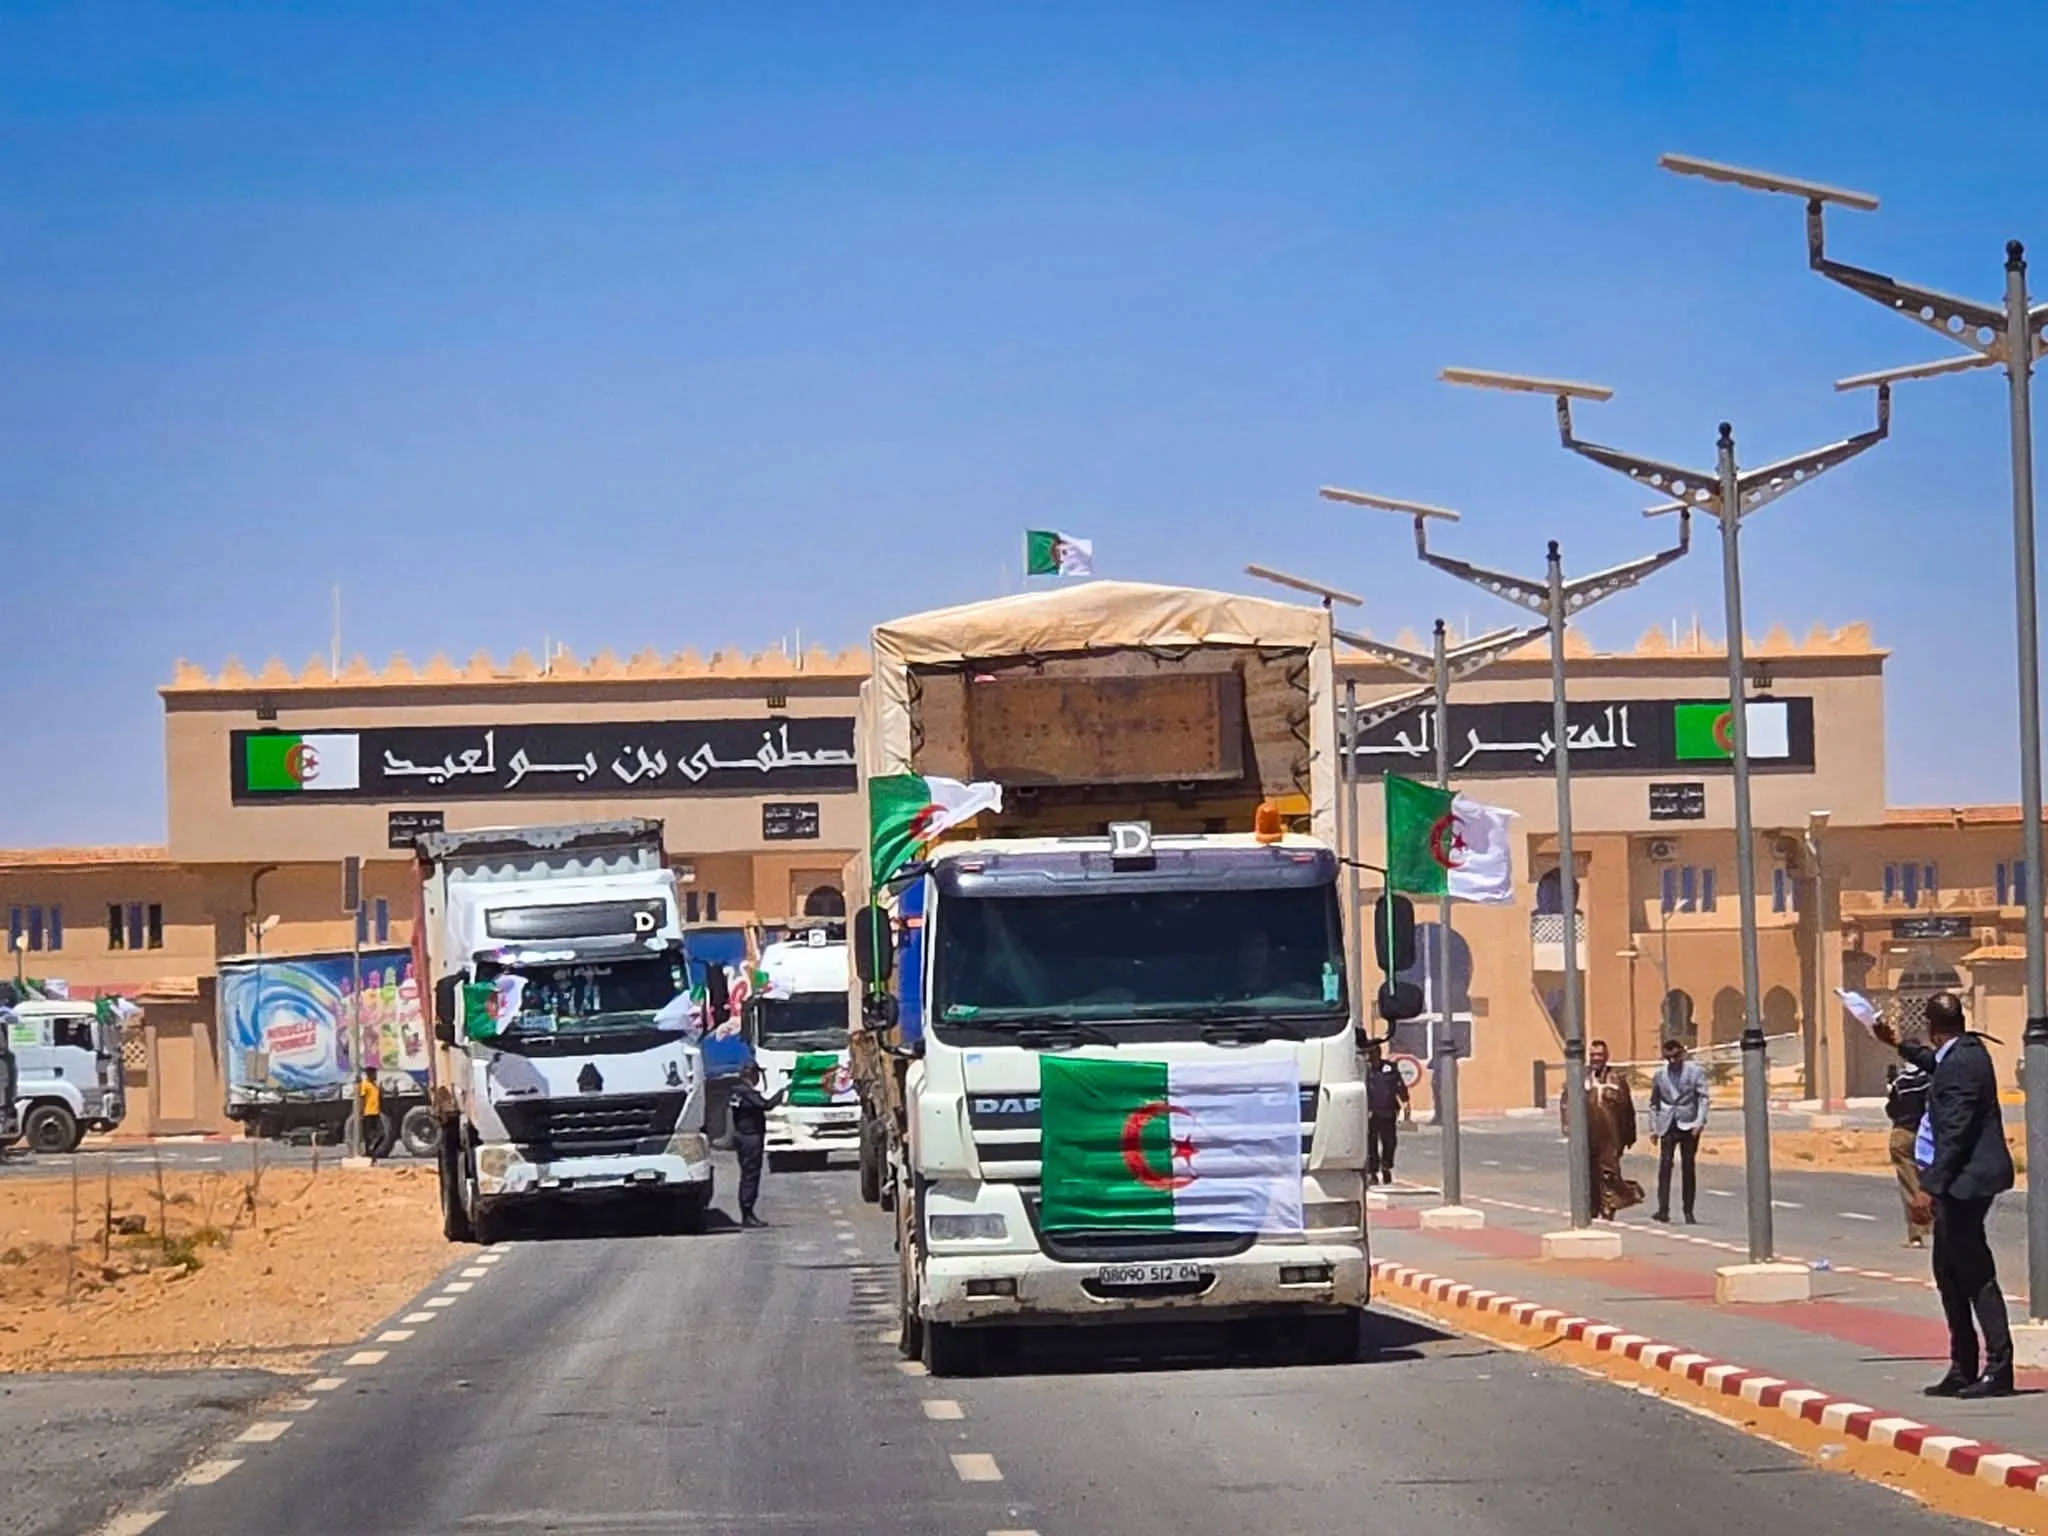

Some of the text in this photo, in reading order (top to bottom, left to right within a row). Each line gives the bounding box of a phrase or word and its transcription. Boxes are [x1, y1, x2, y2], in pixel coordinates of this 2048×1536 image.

[611, 745, 668, 784] بن
[678, 723, 857, 782] صطفى
[1112, 825, 1149, 855] D
[633, 911, 656, 932] D
[1150, 1266, 1174, 1281] 512
